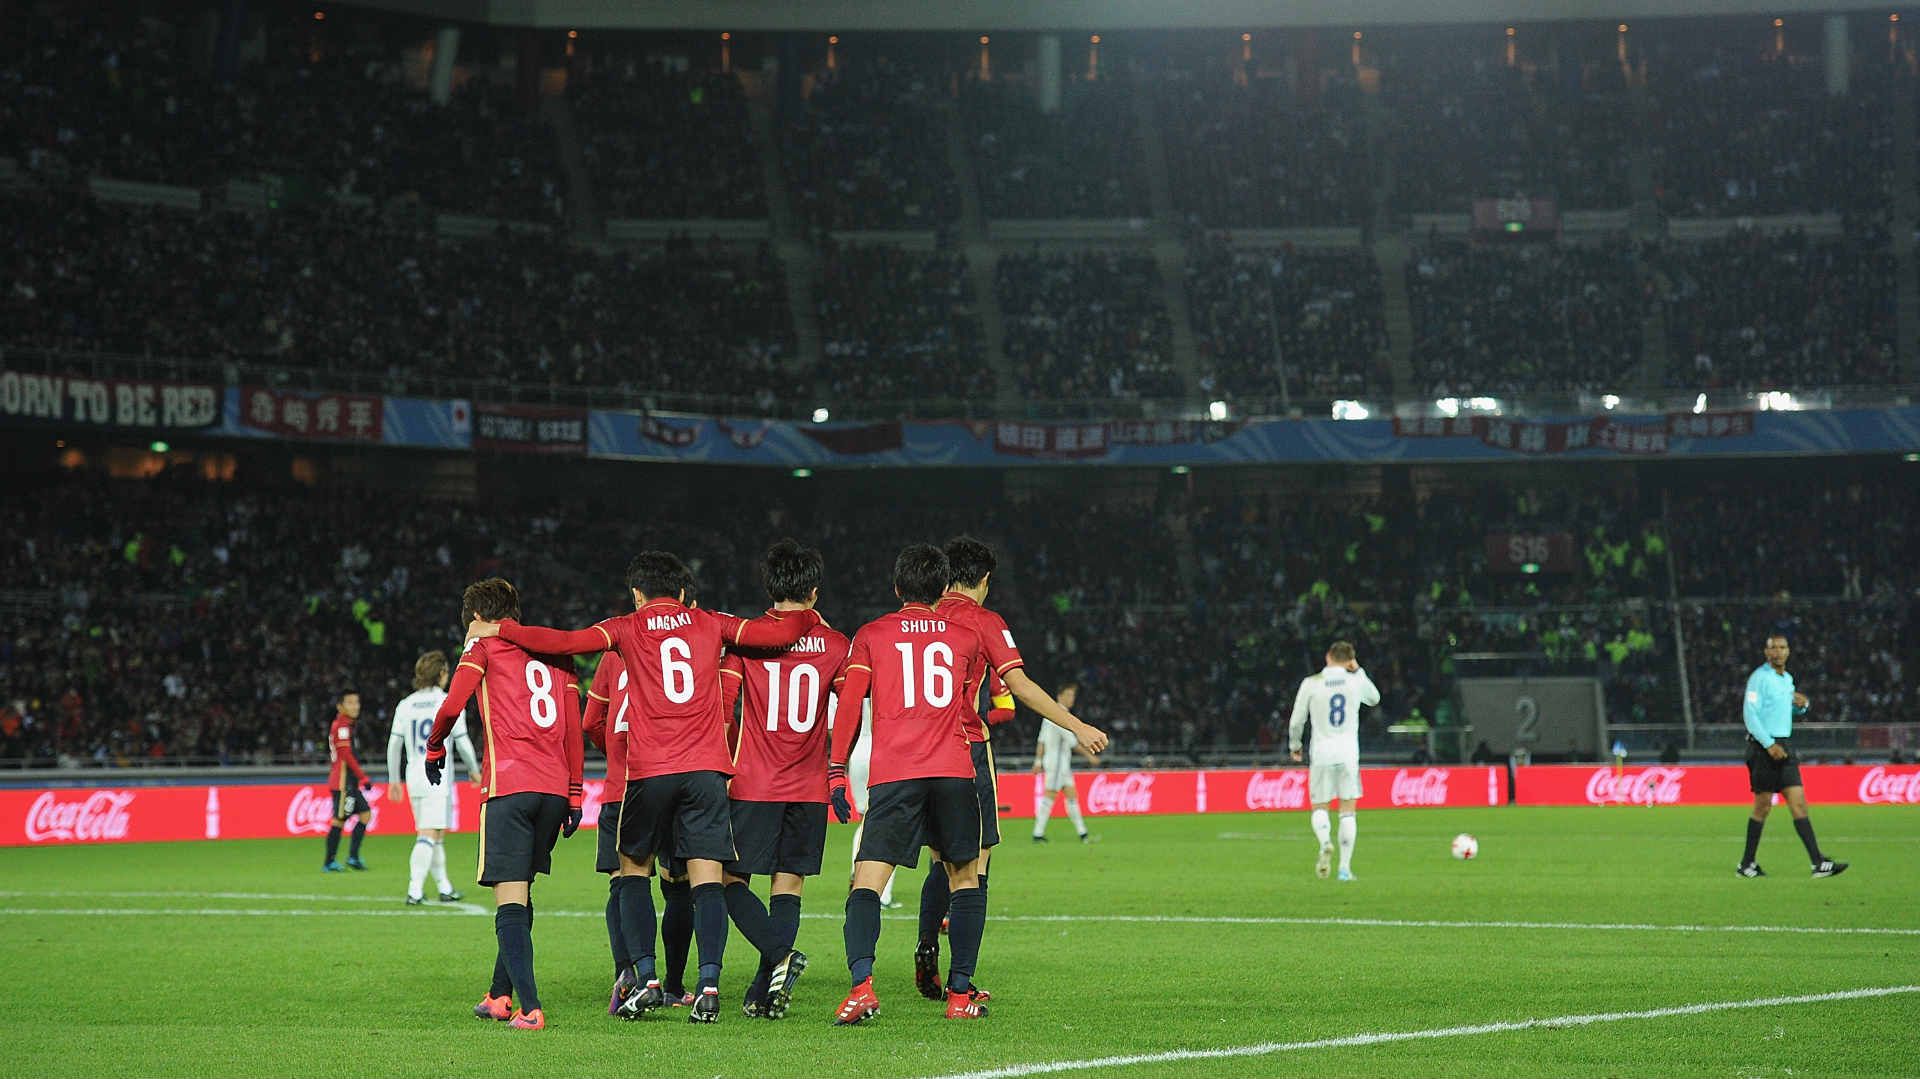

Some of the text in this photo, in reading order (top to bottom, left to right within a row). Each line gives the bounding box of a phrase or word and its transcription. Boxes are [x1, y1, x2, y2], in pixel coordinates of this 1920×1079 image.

[0, 371, 215, 429] ORN TO BE RED
[646, 613, 692, 631] NAGAKI
[785, 636, 826, 653] ASAKI
[900, 620, 947, 633] SHUTO
[525, 660, 557, 728] 8
[660, 637, 695, 704] 6
[894, 641, 954, 709] 16
[763, 661, 819, 733] 10
[1329, 693, 1346, 728] 8
[1515, 696, 1538, 740] 2
